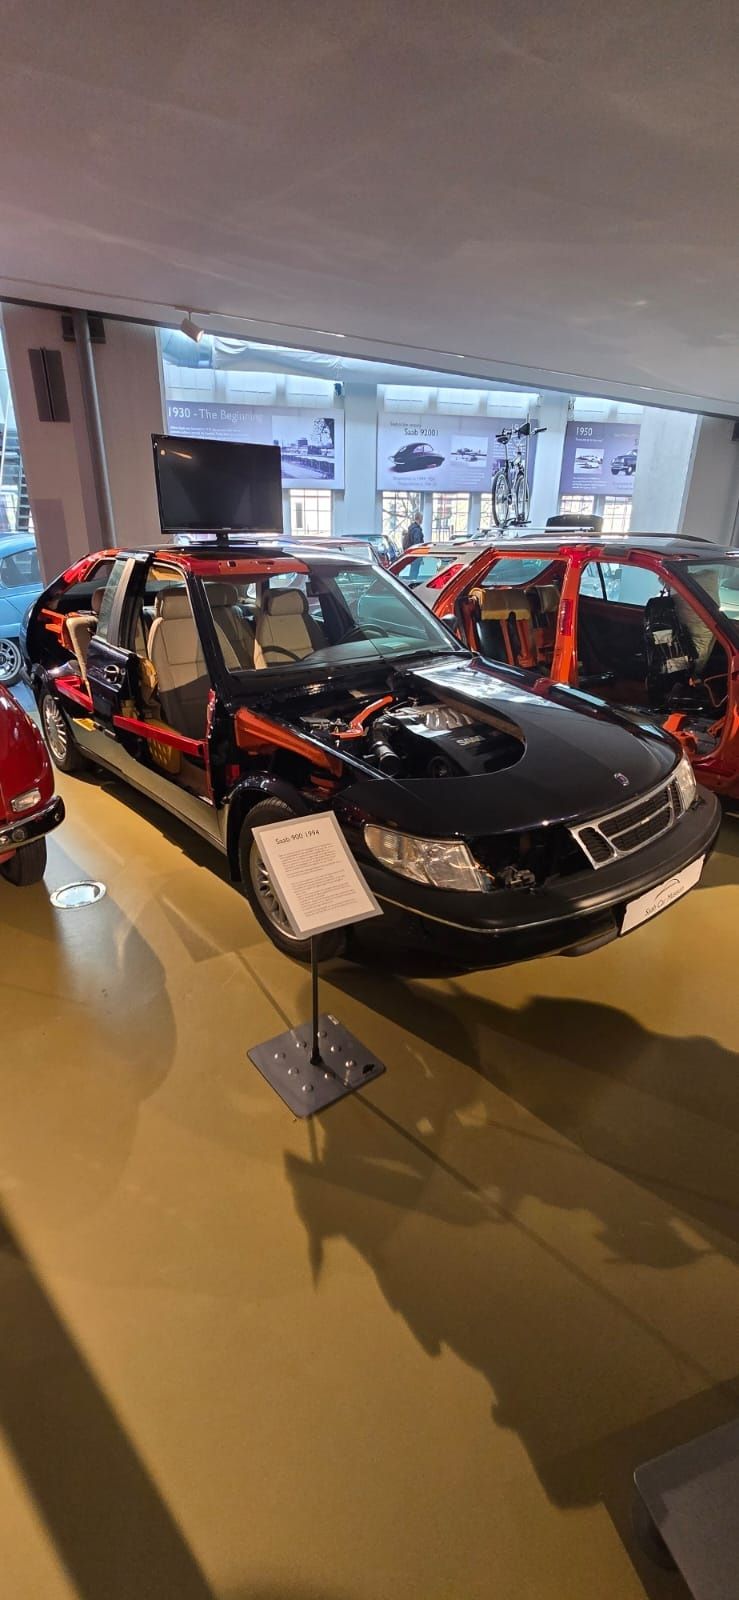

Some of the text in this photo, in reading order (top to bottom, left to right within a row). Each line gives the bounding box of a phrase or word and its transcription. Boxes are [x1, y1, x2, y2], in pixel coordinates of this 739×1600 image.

[168, 406, 191, 418] 1930
[199, 408, 218, 420] The
[220, 410, 263, 424] Beginning
[404, 427, 418, 436] Saab
[576, 426, 593, 436] 1950
[275, 837, 290, 845] Saab
